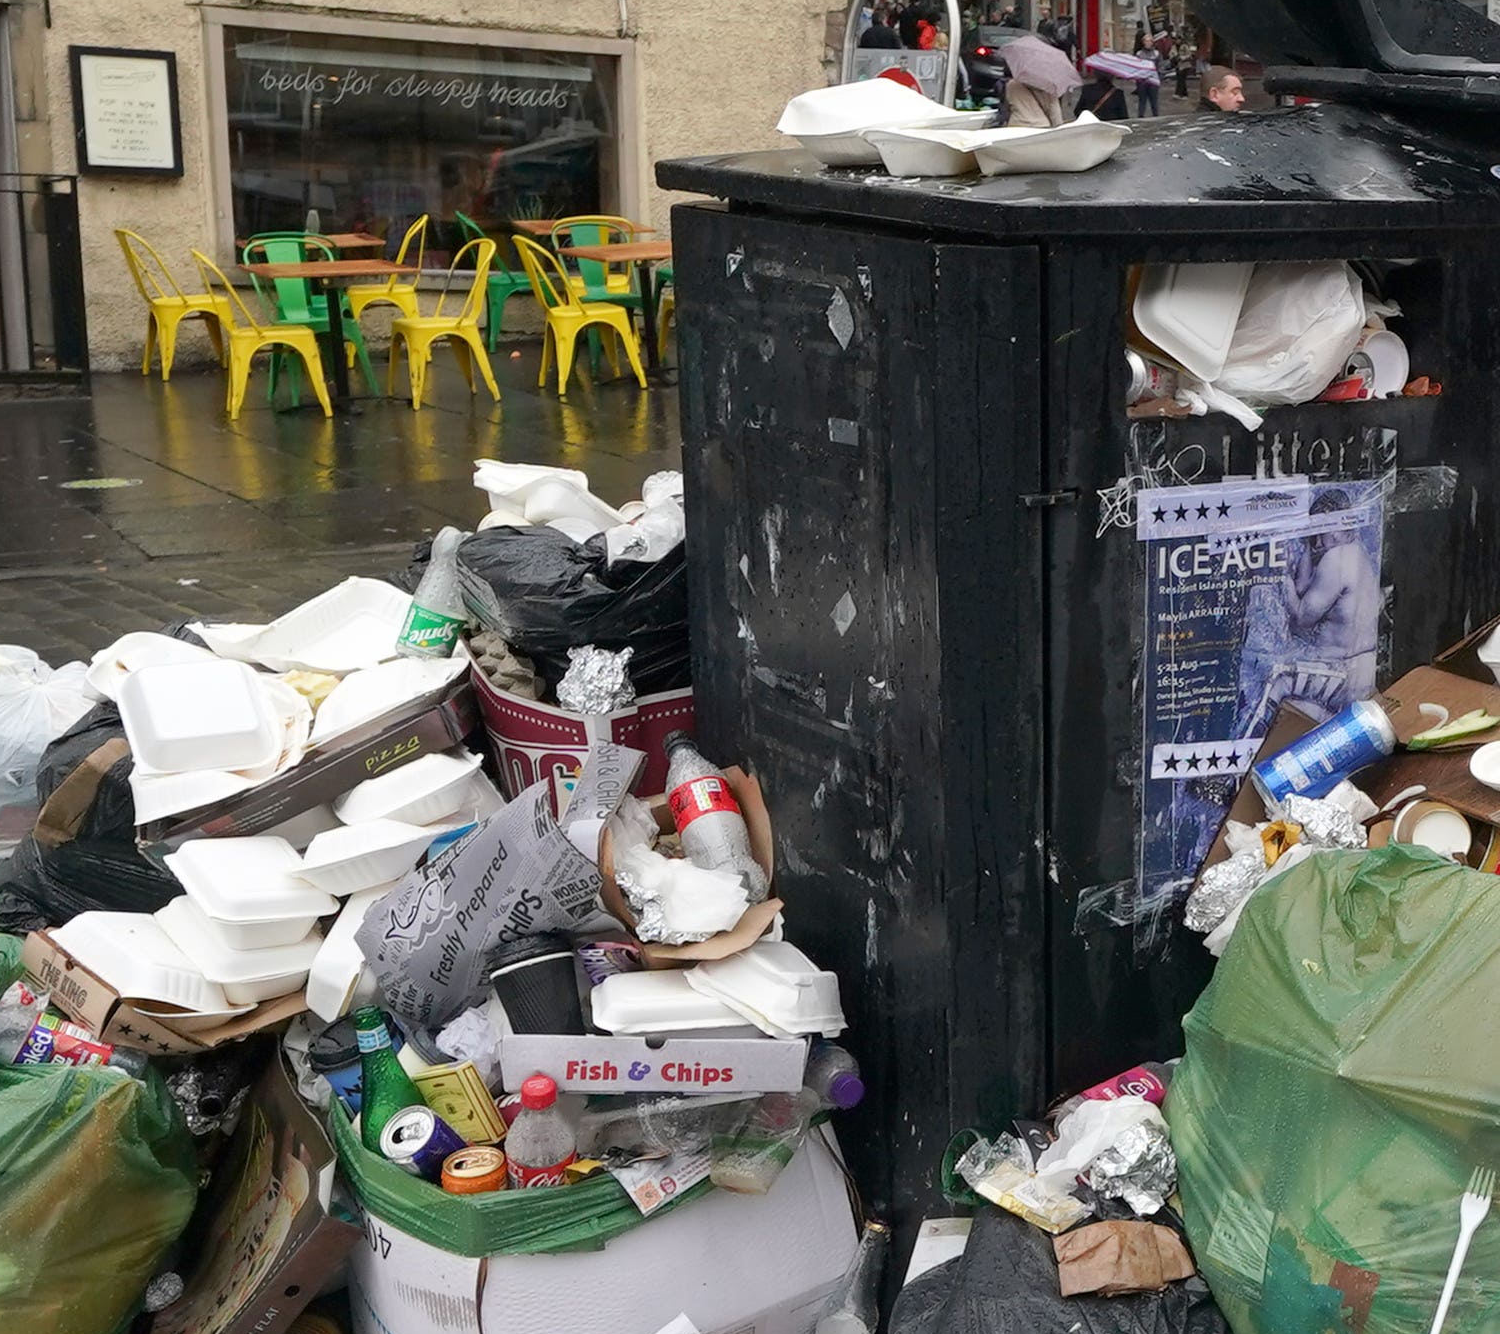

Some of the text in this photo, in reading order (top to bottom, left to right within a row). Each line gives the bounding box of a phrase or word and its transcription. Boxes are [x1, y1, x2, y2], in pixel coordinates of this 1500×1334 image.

[259, 66, 325, 93] beds
[331, 66, 380, 105] for
[384, 77, 483, 109] sleepy
[1159, 538, 1287, 579] ICE AGE
[408, 622, 458, 643] Sprite
[365, 736, 421, 771] pizza
[430, 929, 467, 986] Freshly
[457, 839, 509, 932] Prepared
[40, 958, 61, 985] THE
[61, 974, 88, 1010] KING
[22, 1028, 52, 1064] aked
[566, 1061, 733, 1086] Fish & Chips
[256, 1306, 281, 1332] FLAT
